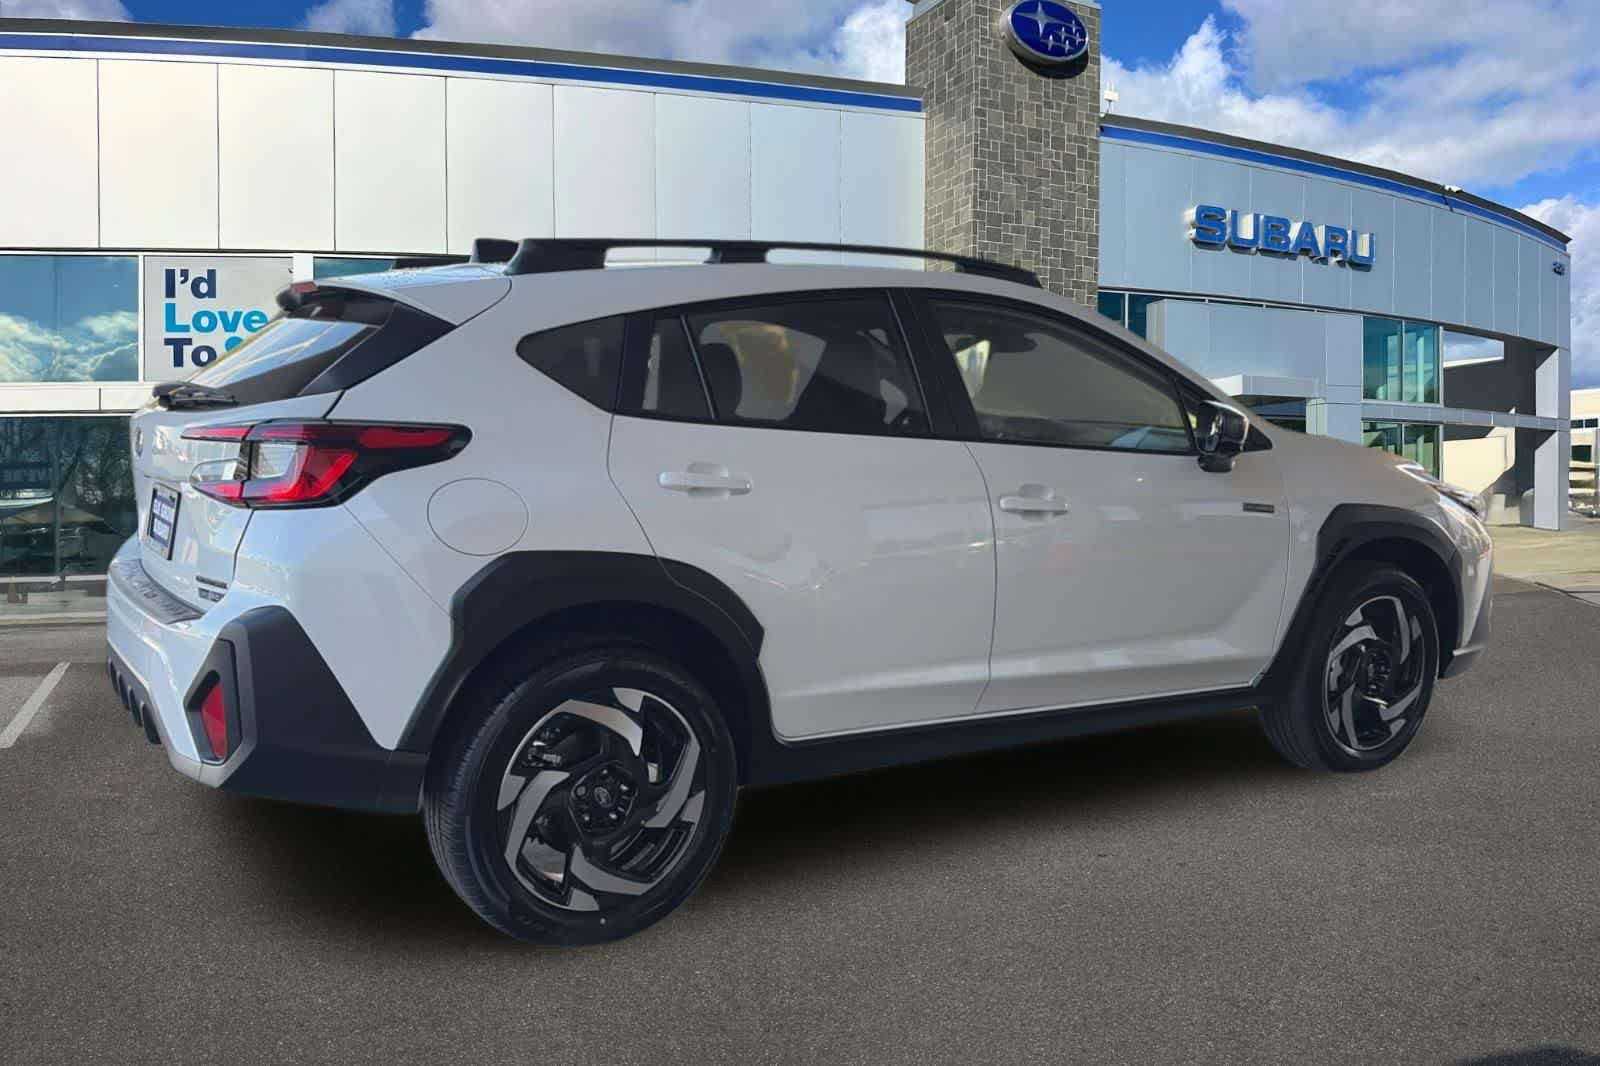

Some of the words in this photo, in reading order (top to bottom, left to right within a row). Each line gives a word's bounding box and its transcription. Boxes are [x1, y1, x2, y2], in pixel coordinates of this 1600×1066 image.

[1194, 204, 1376, 269] SUBARU
[165, 302, 268, 333] Love
[164, 337, 217, 368] To
